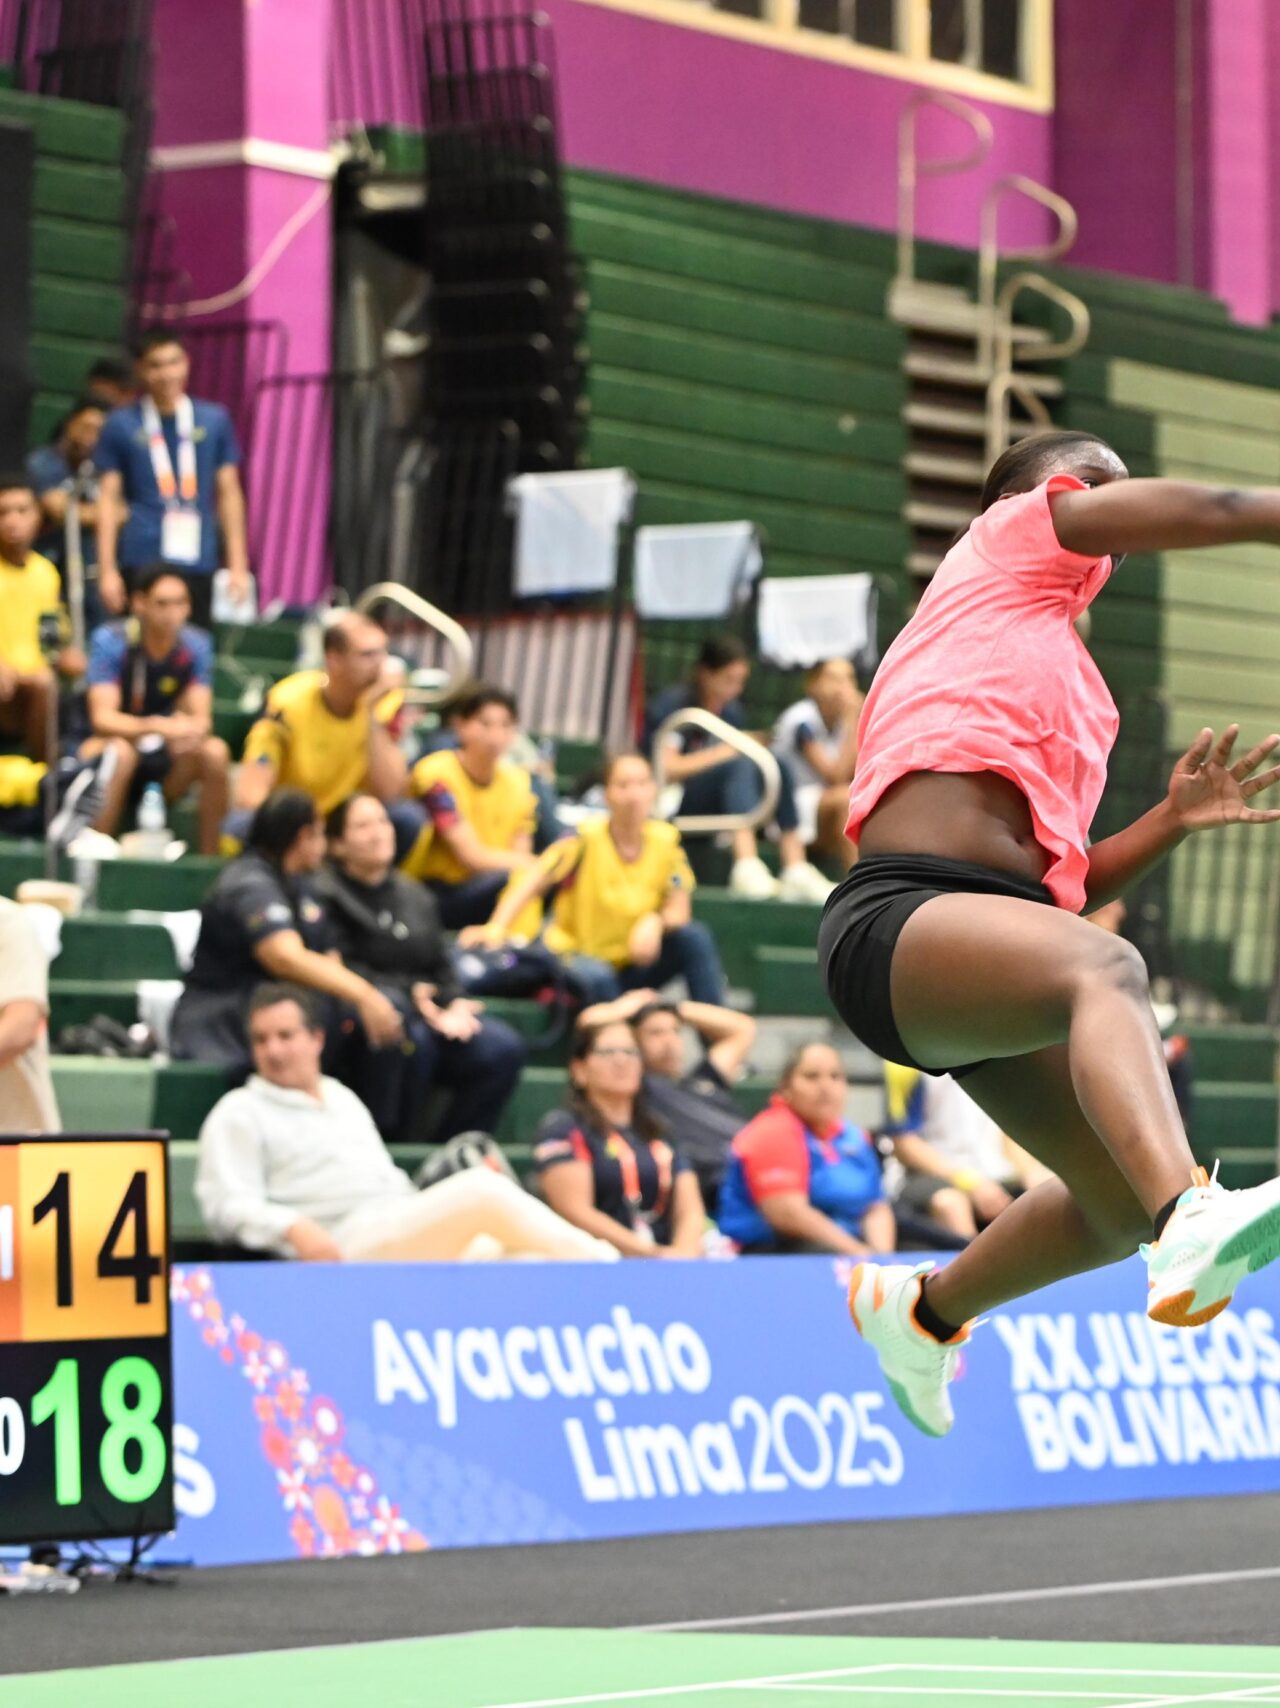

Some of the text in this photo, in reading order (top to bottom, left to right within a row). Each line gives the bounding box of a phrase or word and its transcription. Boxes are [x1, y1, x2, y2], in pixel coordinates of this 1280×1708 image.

[32, 1170, 163, 1307] 14
[372, 1305, 712, 1428] Ayacucho
[991, 1312, 1096, 1392] XX
[31, 1356, 167, 1506] 18
